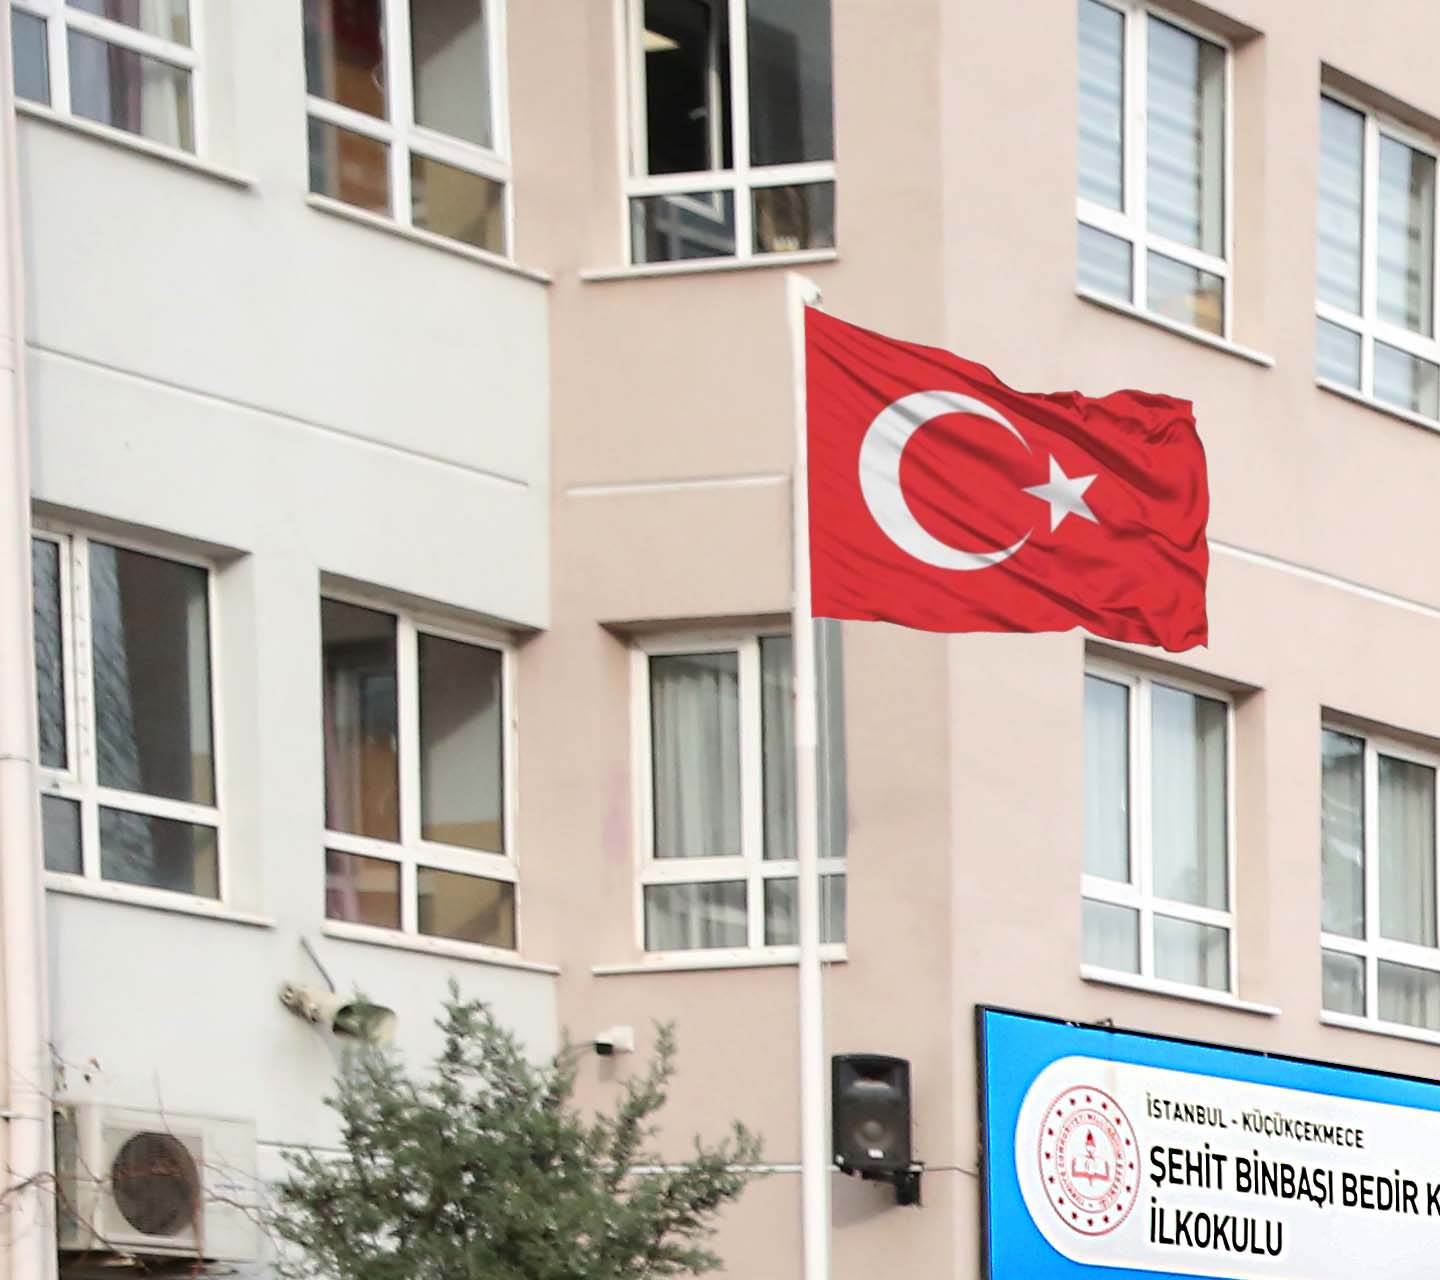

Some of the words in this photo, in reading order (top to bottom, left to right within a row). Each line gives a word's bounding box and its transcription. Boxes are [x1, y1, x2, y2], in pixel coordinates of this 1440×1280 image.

[1146, 1092, 1227, 1128] İSTANBUL
[1241, 1109, 1364, 1149] KÜÇÜKÇEKMECE
[1150, 1142, 1227, 1190] ŞEHİT
[1236, 1149, 1334, 1209] BİNBAŞI
[1342, 1169, 1420, 1215] BEDİR
[1150, 1196, 1283, 1257] İLKOKULU
